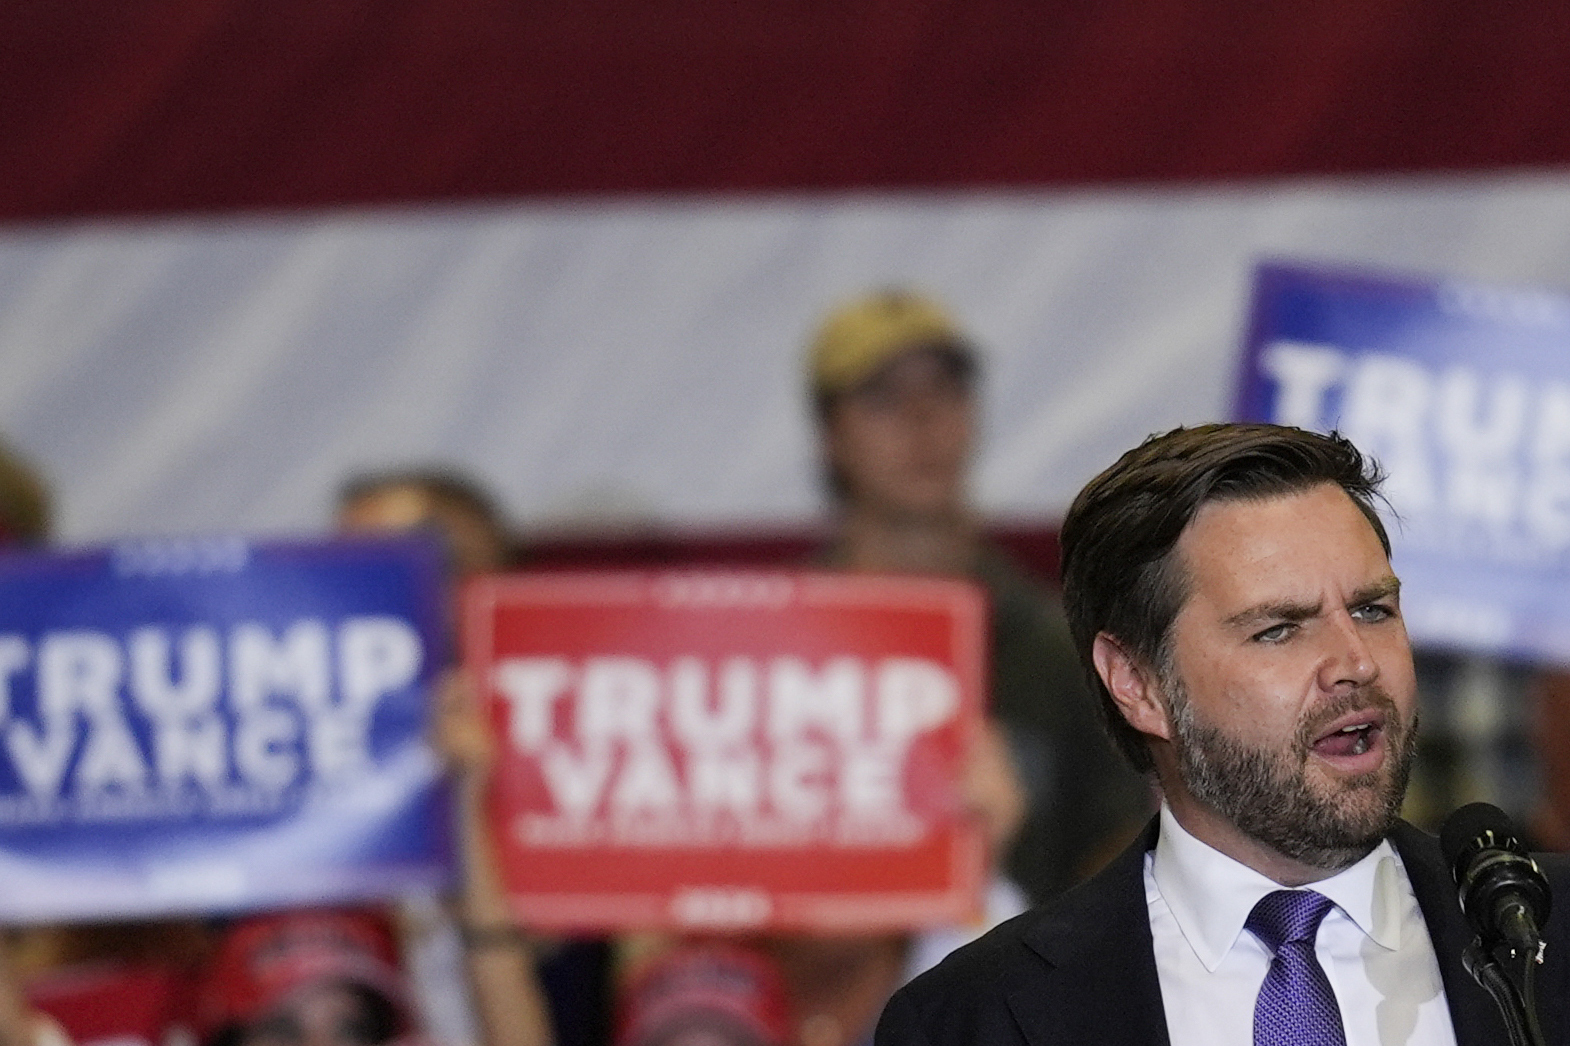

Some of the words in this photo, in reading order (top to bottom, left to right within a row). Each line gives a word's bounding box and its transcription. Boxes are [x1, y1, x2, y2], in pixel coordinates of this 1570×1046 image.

[4, 700, 368, 796] VANCE
[493, 656, 960, 753] TRUMP
[538, 748, 906, 822] VANCE
